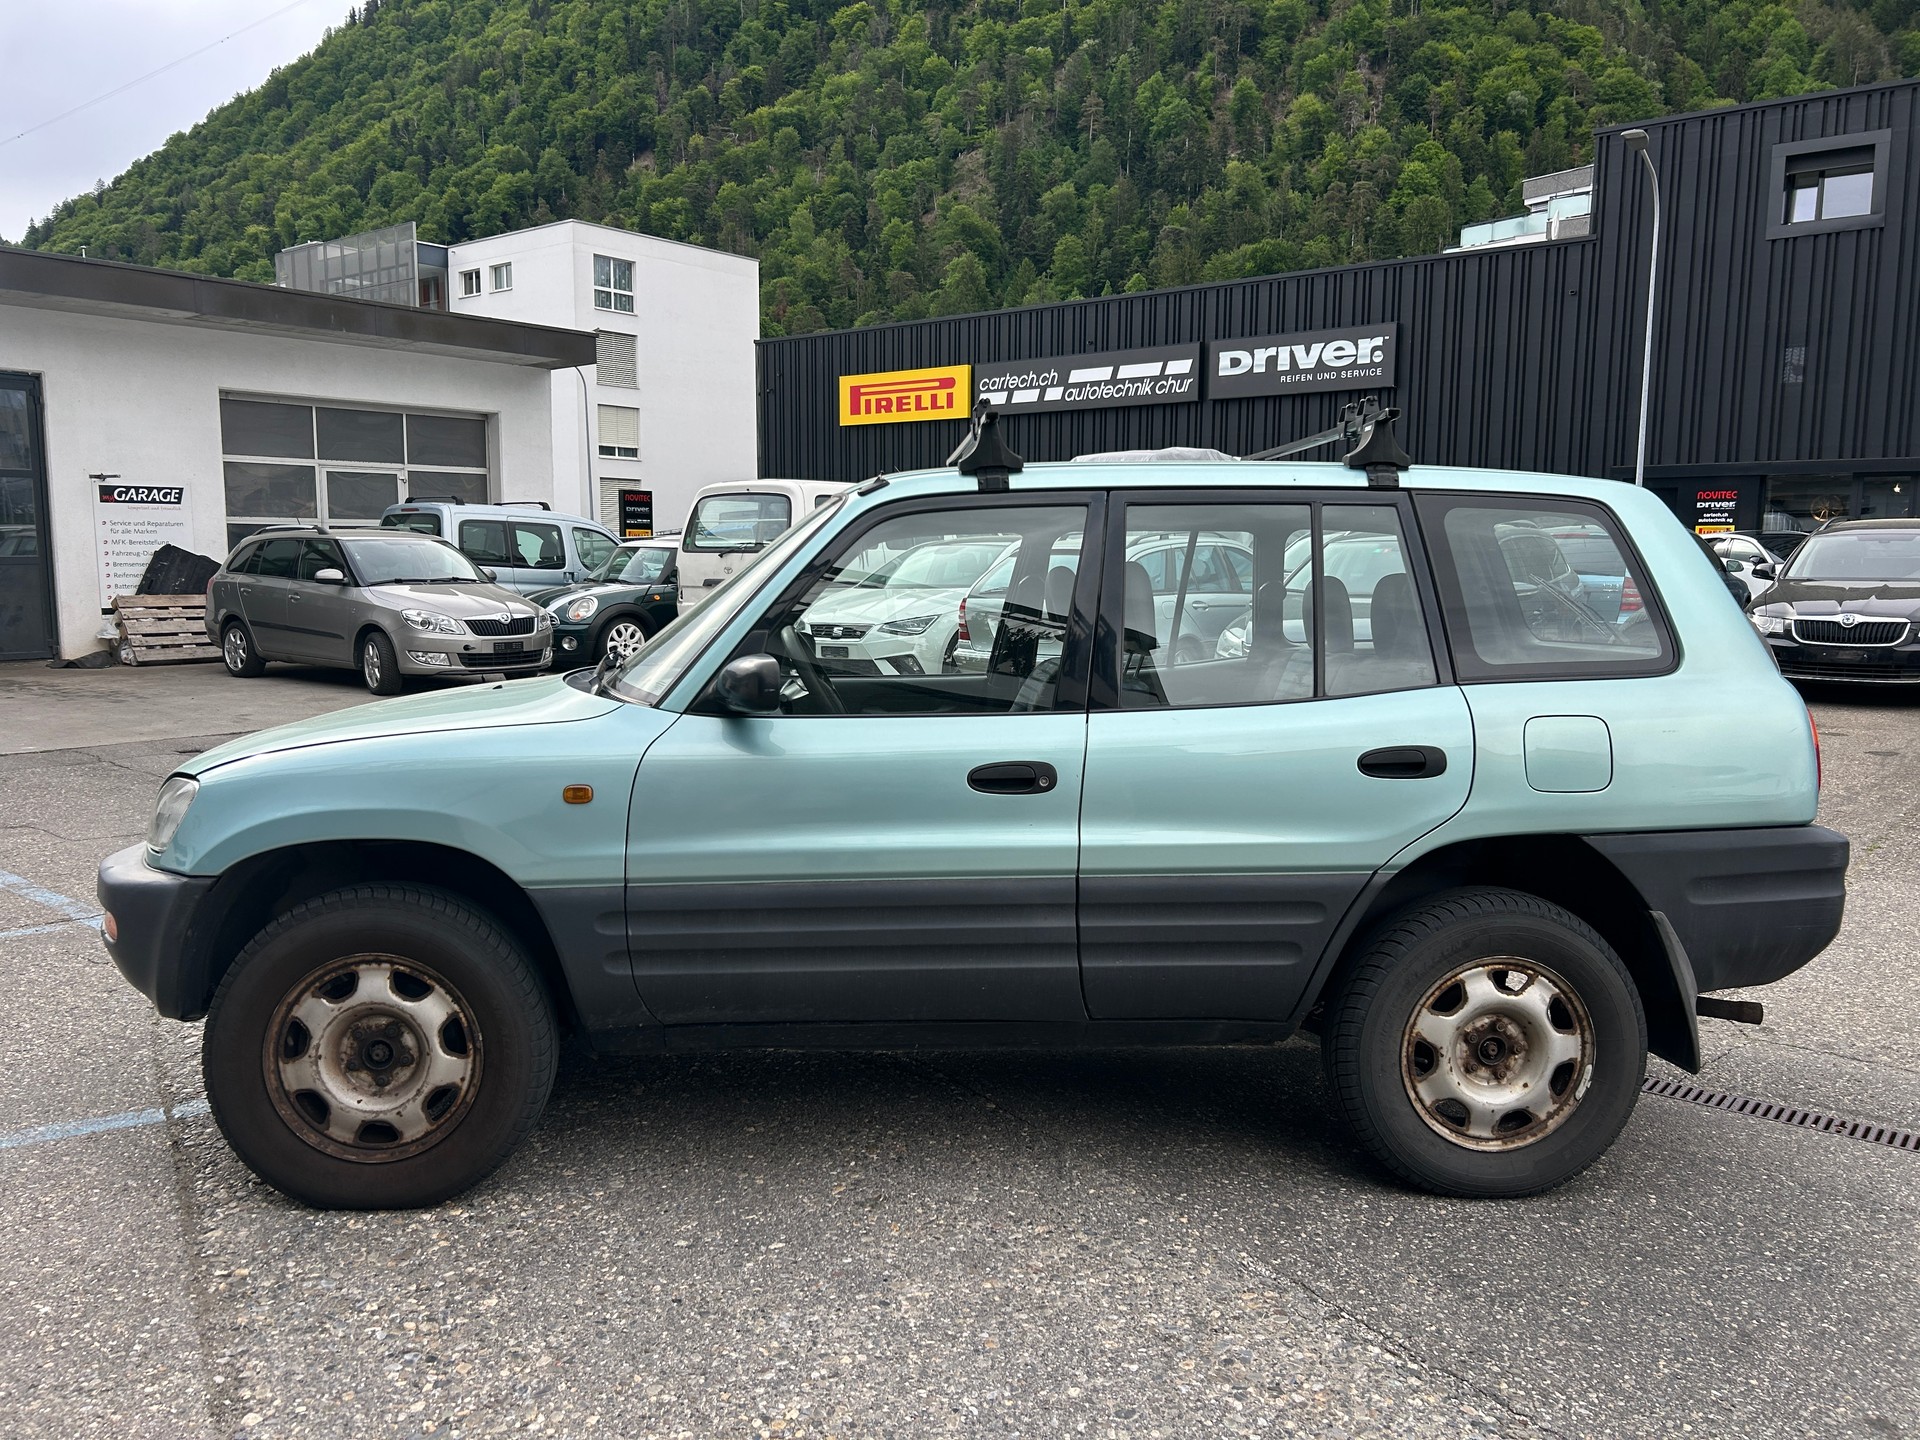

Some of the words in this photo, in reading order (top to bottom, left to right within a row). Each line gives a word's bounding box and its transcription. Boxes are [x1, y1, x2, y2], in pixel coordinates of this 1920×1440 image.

[979, 369, 1058, 391] cartech.ch
[1280, 374, 1313, 383] REIFEN
[1317, 371, 1337, 381] UND
[1341, 367, 1383, 379] SERVICE
[850, 377, 956, 416] PIRELLI
[1065, 379, 1156, 402] autotechnik
[1155, 377, 1194, 396] chur
[1697, 491, 1738, 499] NOVITEC
[110, 527, 119, 535] für
